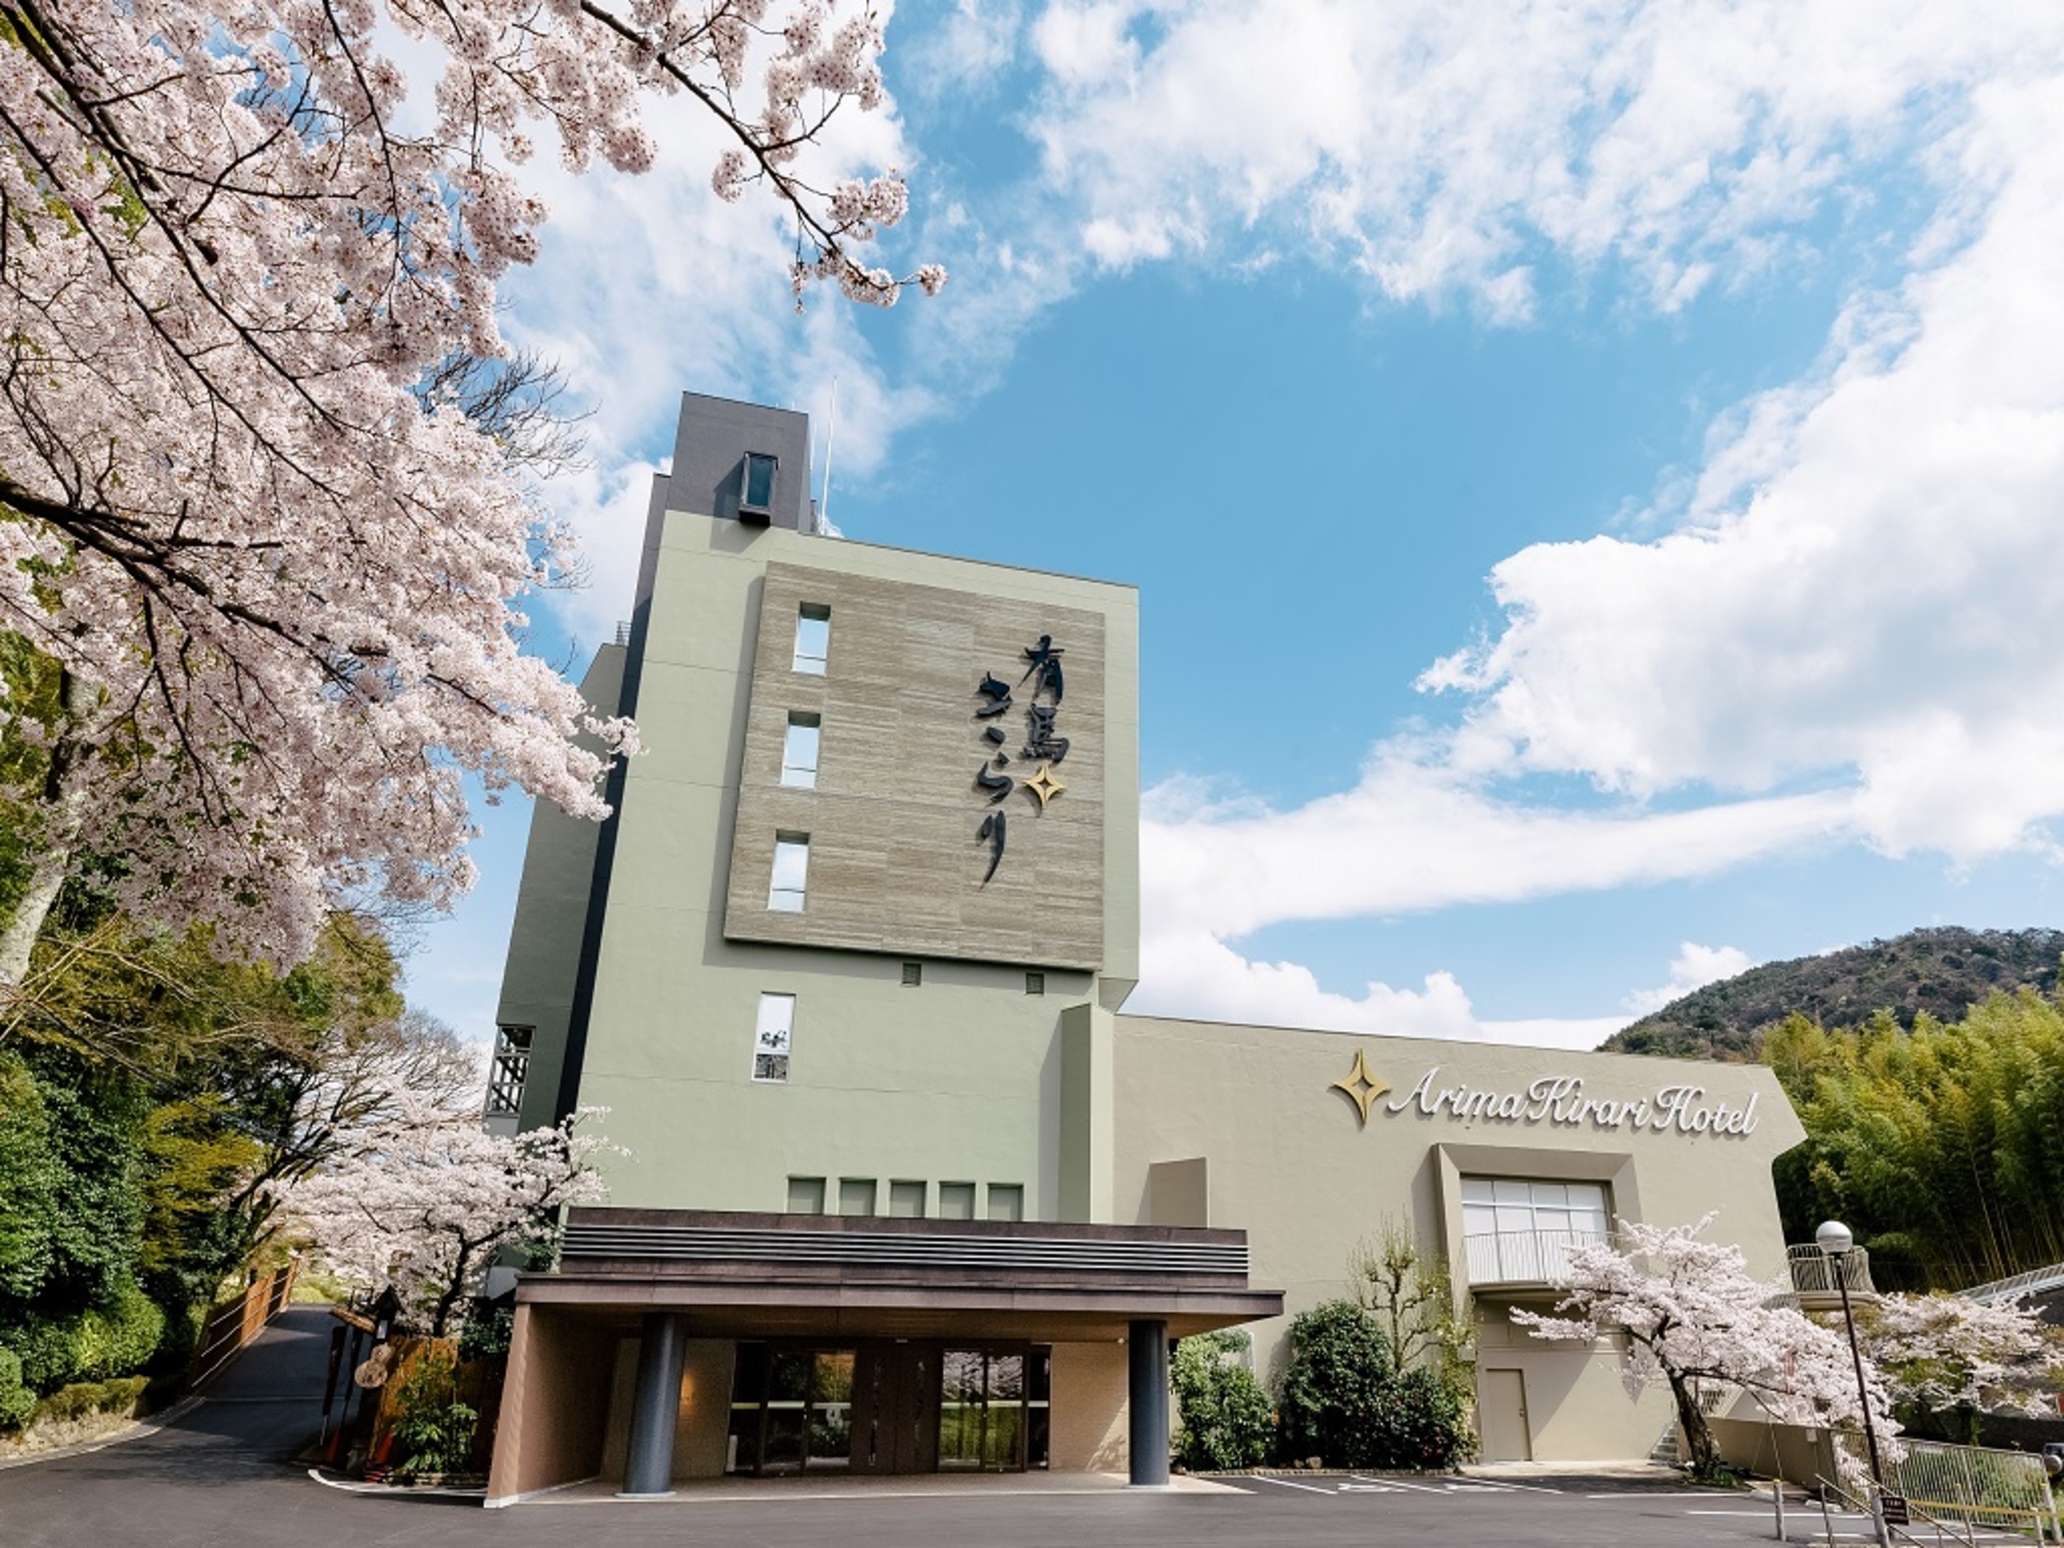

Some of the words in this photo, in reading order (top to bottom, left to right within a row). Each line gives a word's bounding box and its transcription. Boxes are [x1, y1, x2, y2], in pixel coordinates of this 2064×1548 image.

[1017, 634, 1069, 763] 有馬
[976, 671, 1013, 890] きらり
[1388, 1066, 1528, 1119] Arima
[1528, 1075, 1651, 1128] Kirari
[1653, 1085, 1759, 1135] Hotel
